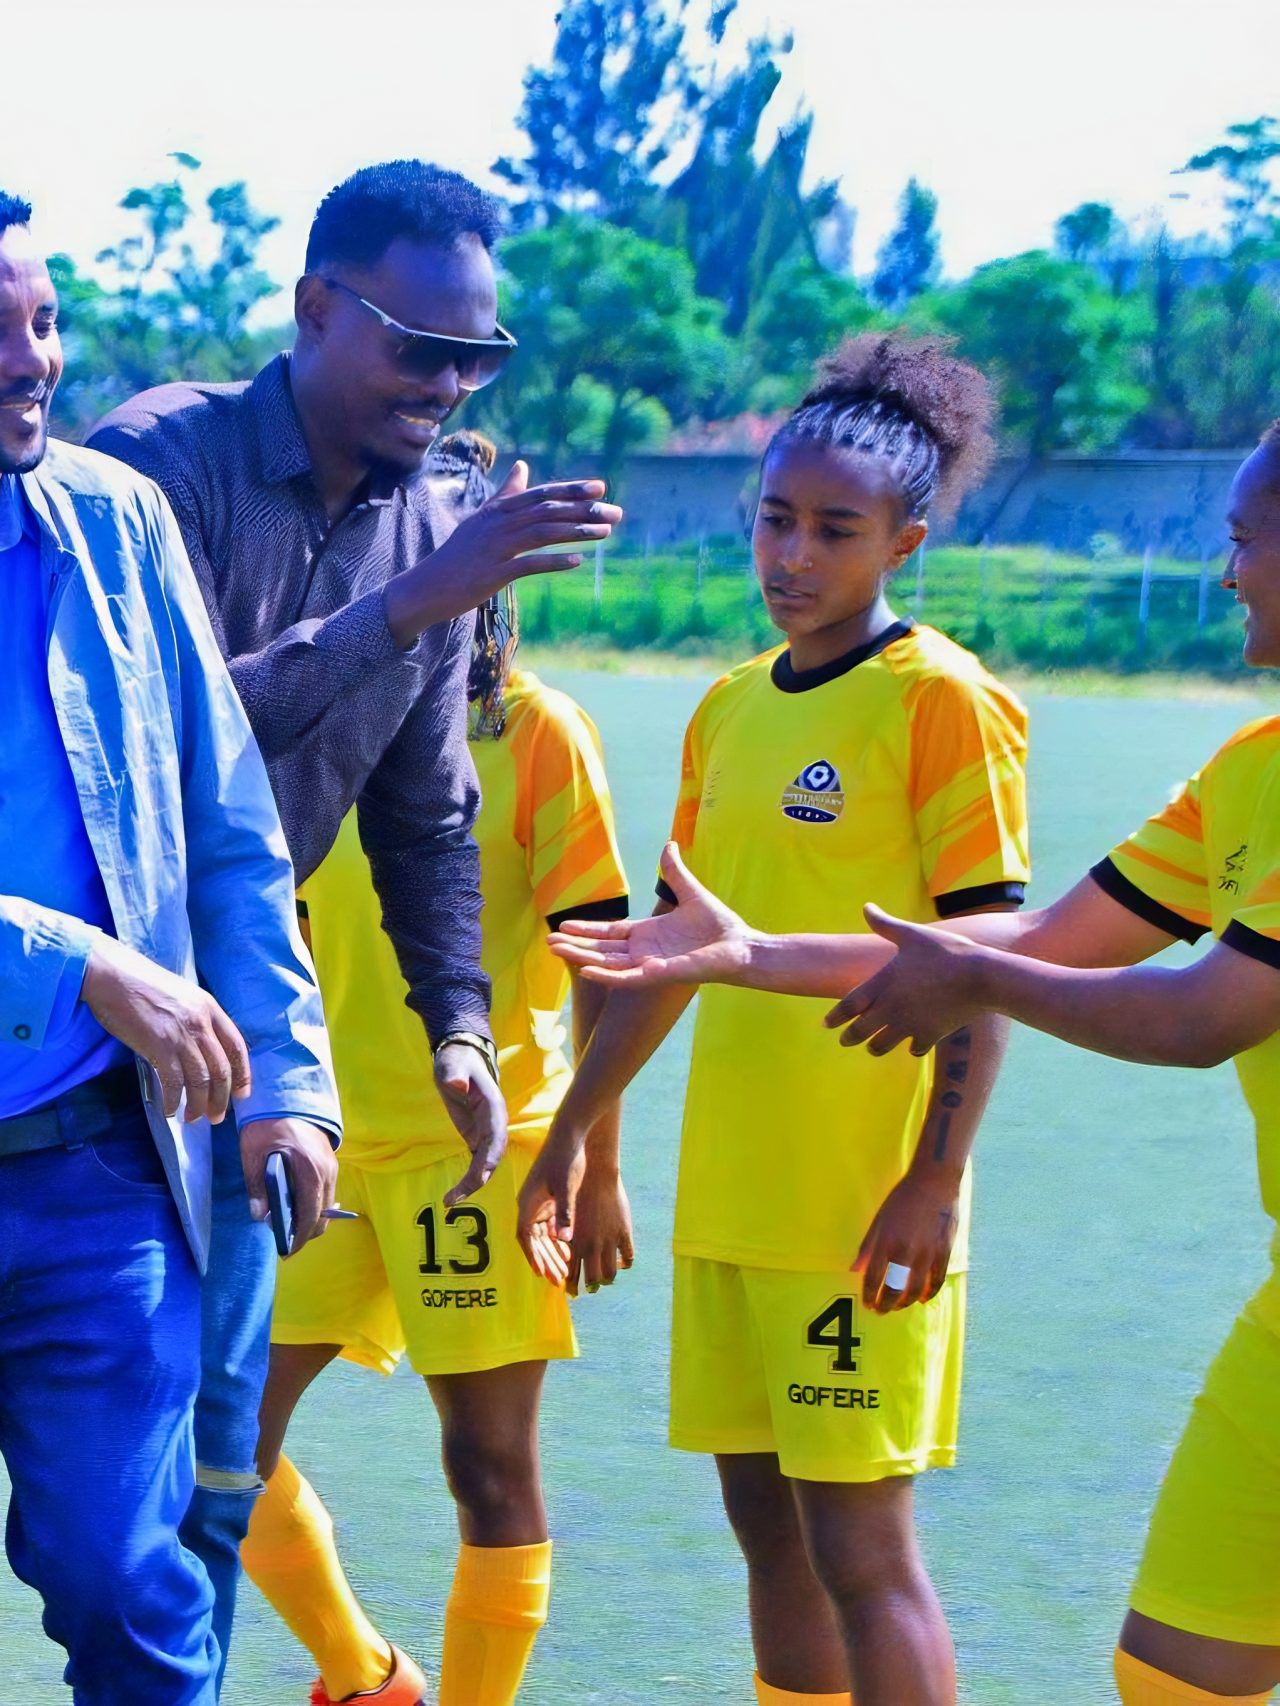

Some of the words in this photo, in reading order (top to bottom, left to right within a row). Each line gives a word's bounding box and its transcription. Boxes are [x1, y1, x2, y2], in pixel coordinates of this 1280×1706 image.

[417, 1206, 490, 1274] 13
[421, 1288, 498, 1308] GOFERE
[807, 1297, 861, 1371] 4
[788, 1383, 880, 1409] GOFERE
